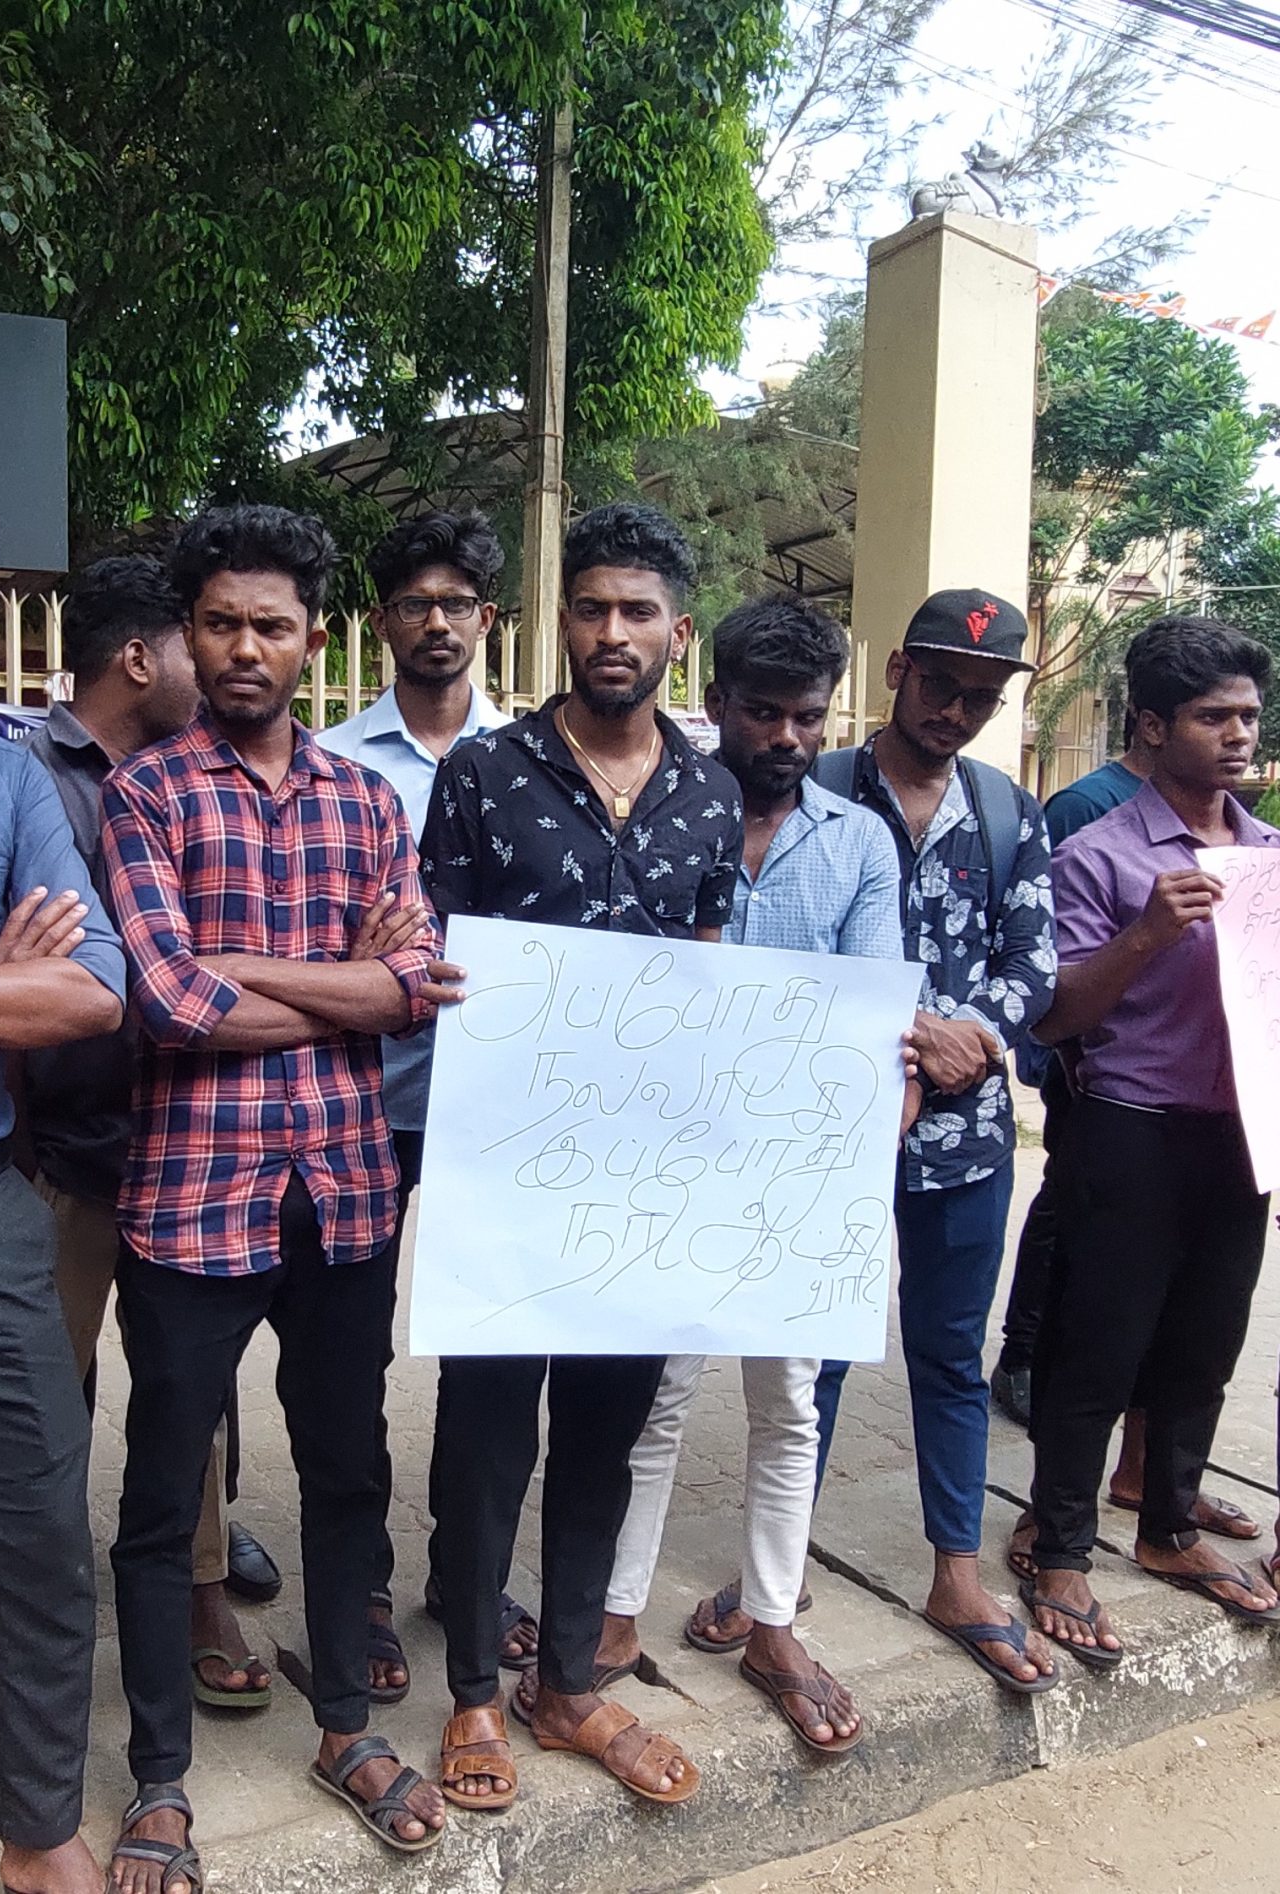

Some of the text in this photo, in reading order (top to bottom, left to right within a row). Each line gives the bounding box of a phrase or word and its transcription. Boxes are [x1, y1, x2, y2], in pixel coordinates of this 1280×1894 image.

[7, 723, 31, 740] Int
[458, 940, 838, 1097] அப்போது
[515, 1119, 866, 1232] இப்போது
